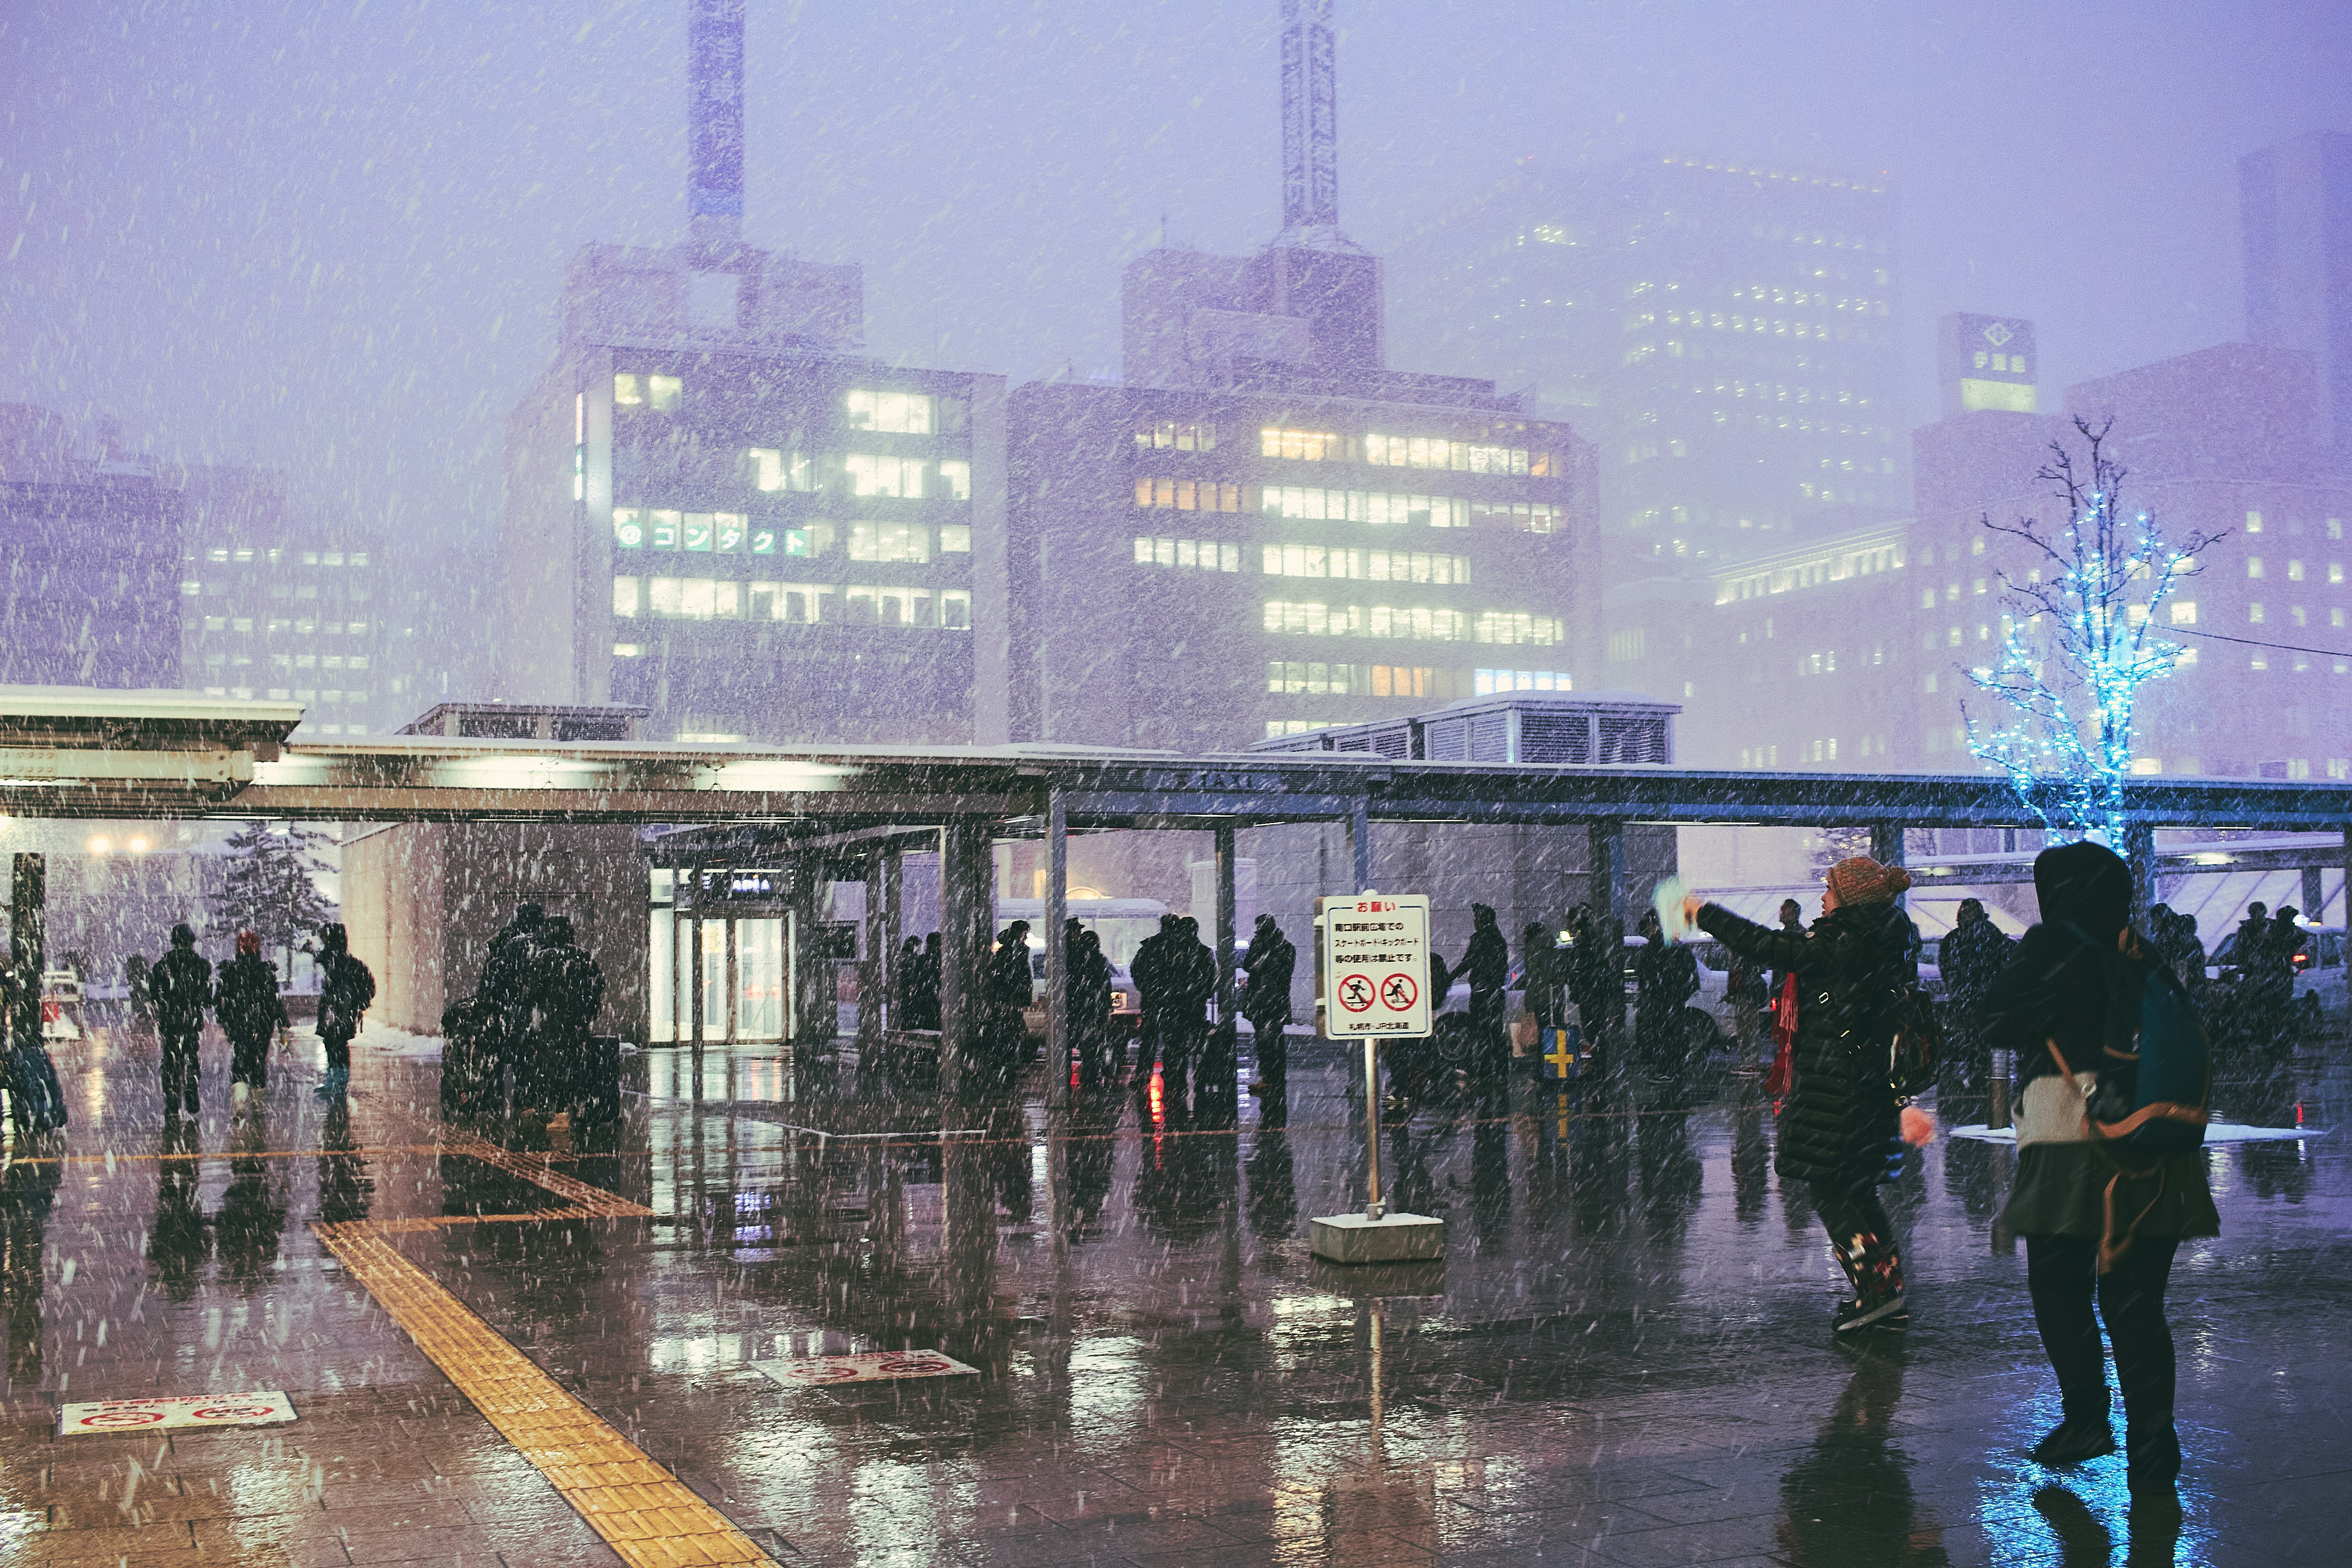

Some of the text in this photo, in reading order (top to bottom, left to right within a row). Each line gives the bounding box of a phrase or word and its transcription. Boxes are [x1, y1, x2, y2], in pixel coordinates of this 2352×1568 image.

[620, 524, 804, 553] @コンタクト
[1357, 902, 1396, 912] お願い
